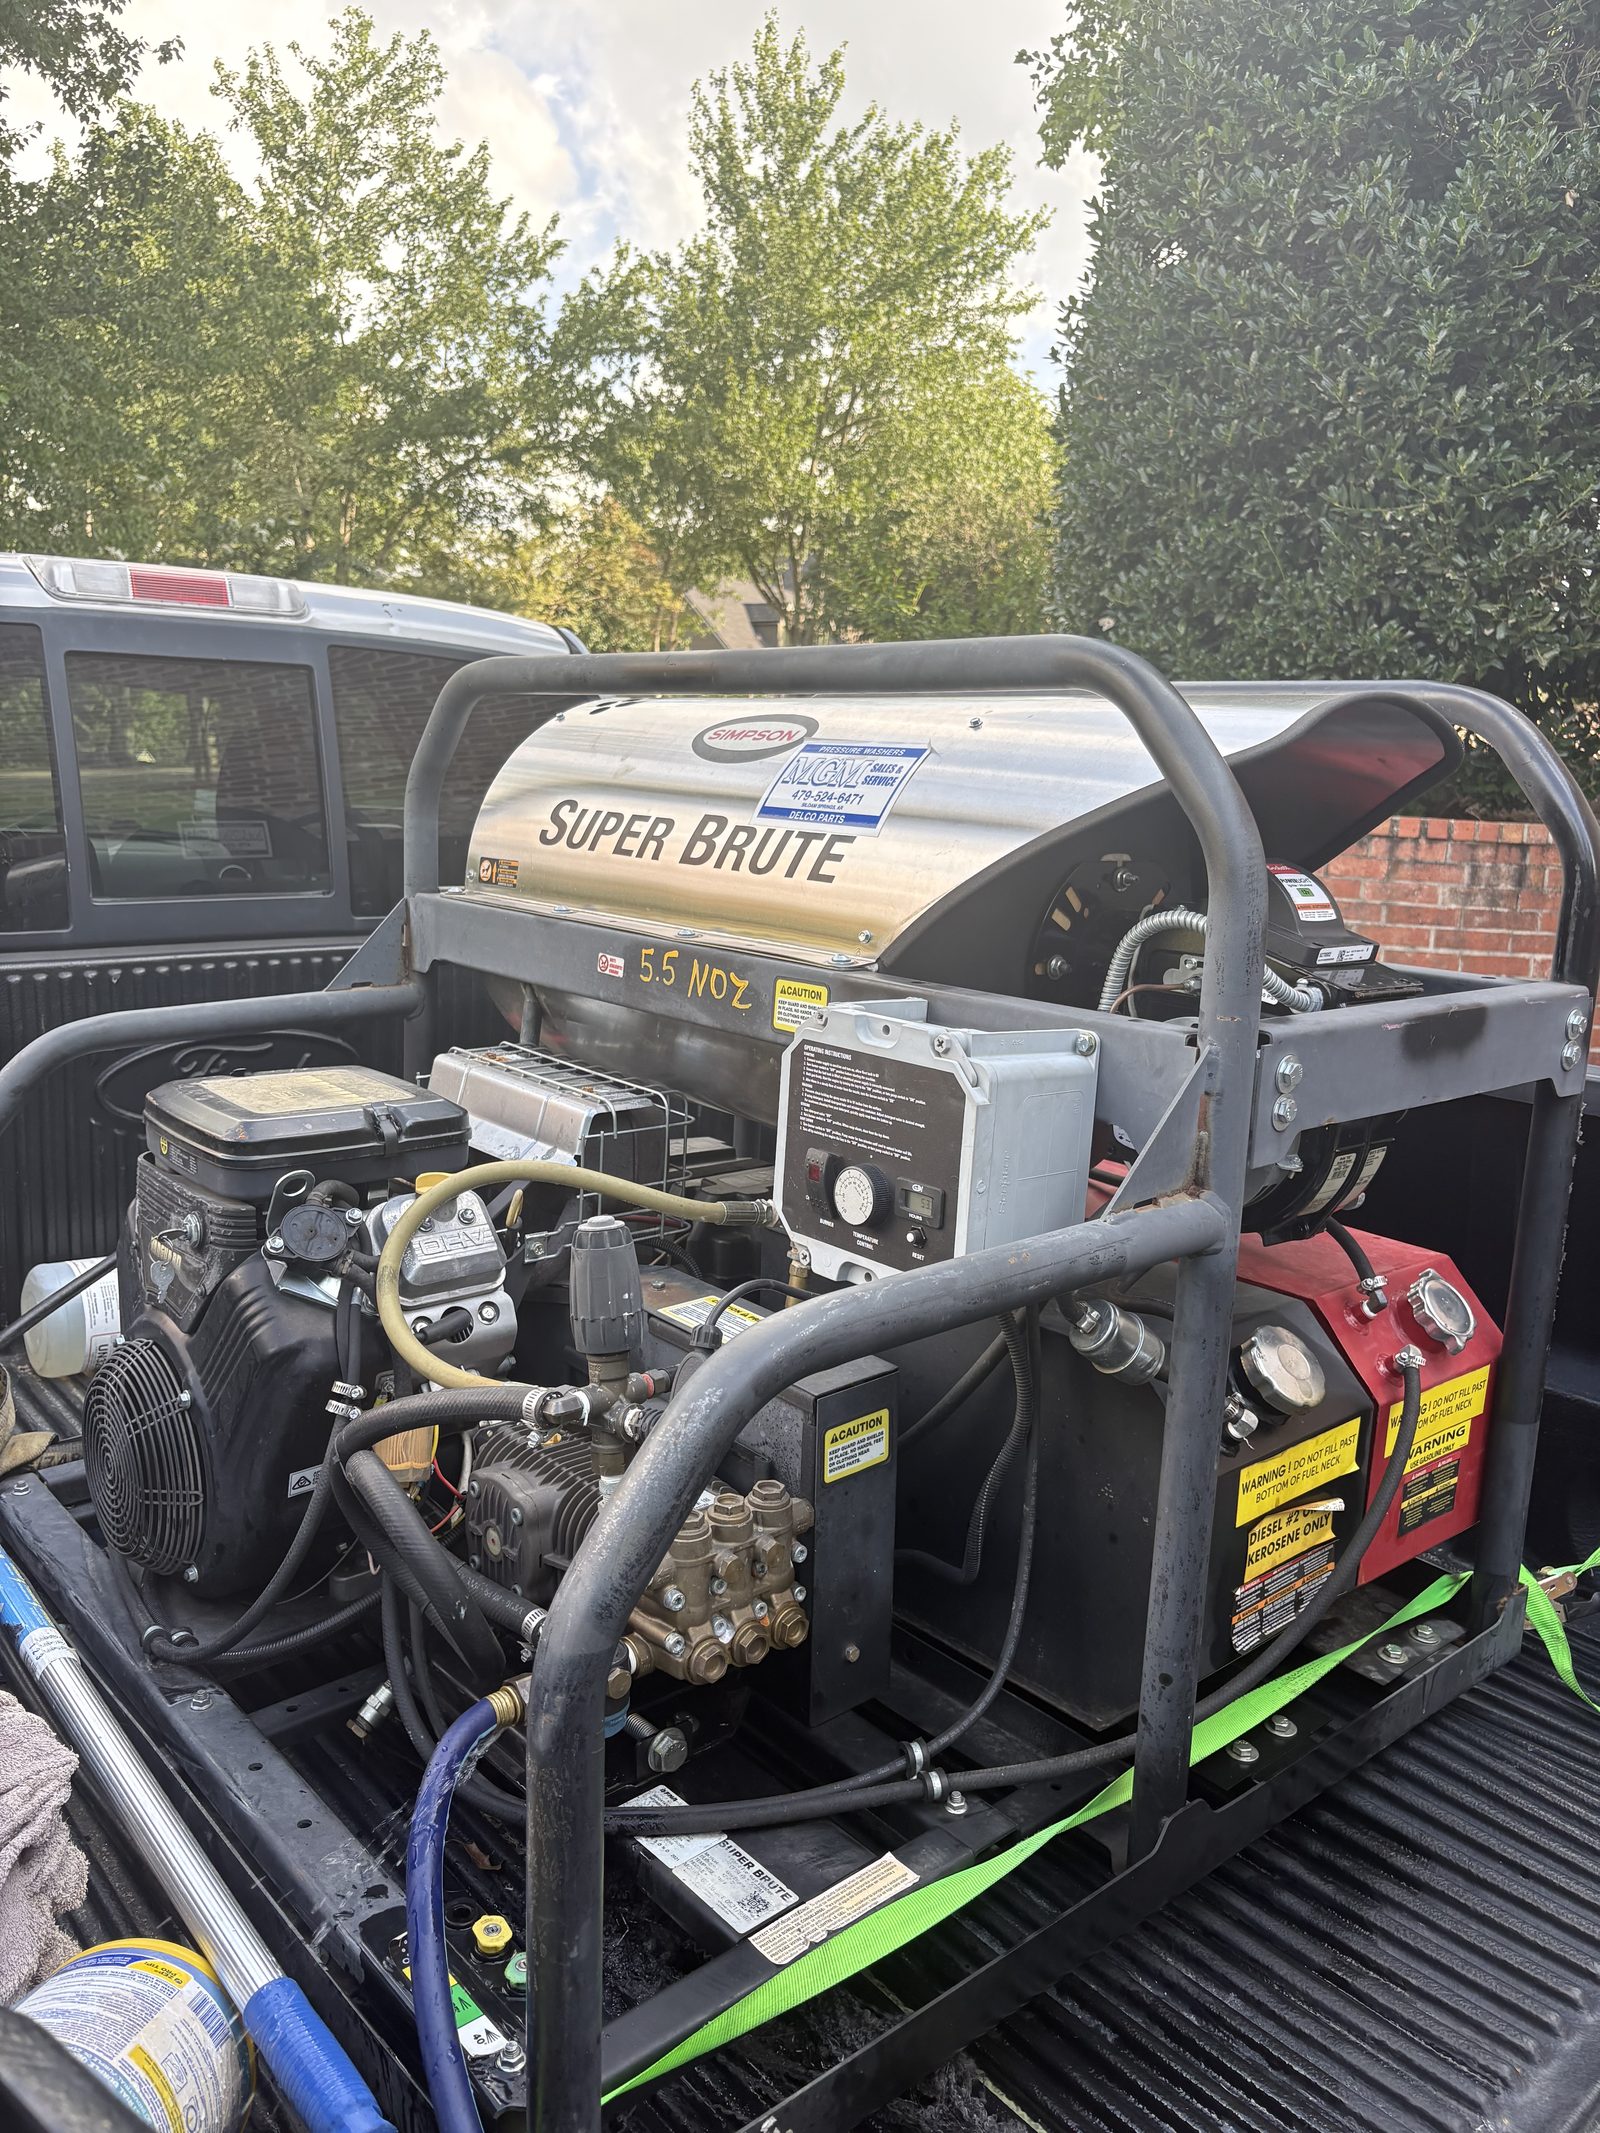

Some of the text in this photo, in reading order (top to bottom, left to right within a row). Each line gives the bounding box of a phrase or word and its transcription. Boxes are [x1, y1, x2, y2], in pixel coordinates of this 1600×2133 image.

[708, 729, 800, 742] SIMPSON
[818, 746, 906, 756] PRESSURE WASHERS
[781, 757, 904, 788] MGM SALES &
[861, 775, 899, 787] SERVICE
[792, 790, 865, 805] 479-524-6471
[789, 811, 845, 824] DELCO PARTS
[539, 799, 857, 884] SUPER BRUTE
[640, 948, 679, 986] 5.5
[787, 986, 822, 1001] CAUTION
[804, 1044, 852, 1061] OPERATING INSTRUCTIONS
[820, 1218, 835, 1228] BURNER
[909, 1213, 923, 1222] HOURS
[853, 1231, 879, 1246] TEMPERATURE
[857, 1240, 874, 1251] CONTROL
[912, 1252, 925, 1261] RESET
[1433, 1398, 1443, 1410] DO
[1443, 1391, 1459, 1406] NOT
[1458, 1385, 1471, 1399] FILL
[1472, 1380, 1487, 1393] PAST
[1429, 1415, 1438, 1424] OF
[1439, 1407, 1454, 1420] FUEL
[1455, 1398, 1473, 1412] NECK
[839, 1416, 883, 1441] CAUTION
[829, 1448, 841, 1456] KEEP
[841, 1442, 857, 1452] GUARD
[866, 1431, 884, 1440] SHIELDS
[874, 1437, 885, 1445] FEET
[836, 1454, 858, 1465] CLOTHING
[858, 1448, 870, 1456] NEAR
[1242, 1465, 1286, 1495] WARNING
[1293, 1458, 1306, 1471] DO
[1307, 1449, 1324, 1465] NOT
[1324, 1442, 1338, 1457] FILL
[1340, 1434, 1357, 1450] PAST
[1410, 1461, 1419, 1469] USE
[1420, 1448, 1442, 1466] GASOLINE
[1442, 1443, 1455, 1454] ONLY
[829, 1465, 846, 1474] MOVING
[1256, 1455, 1341, 1503] BOTTOM OF FUEL NECK
[1249, 1519, 1283, 1546] DIESEL
[1285, 1510, 1300, 1527] #2
[1248, 1512, 1331, 1567] KEROSENE ONLY
[720, 1840, 755, 1870] SUPER
[753, 1869, 793, 1902] BRUTE
[751, 1929, 771, 1943] PROTECT
